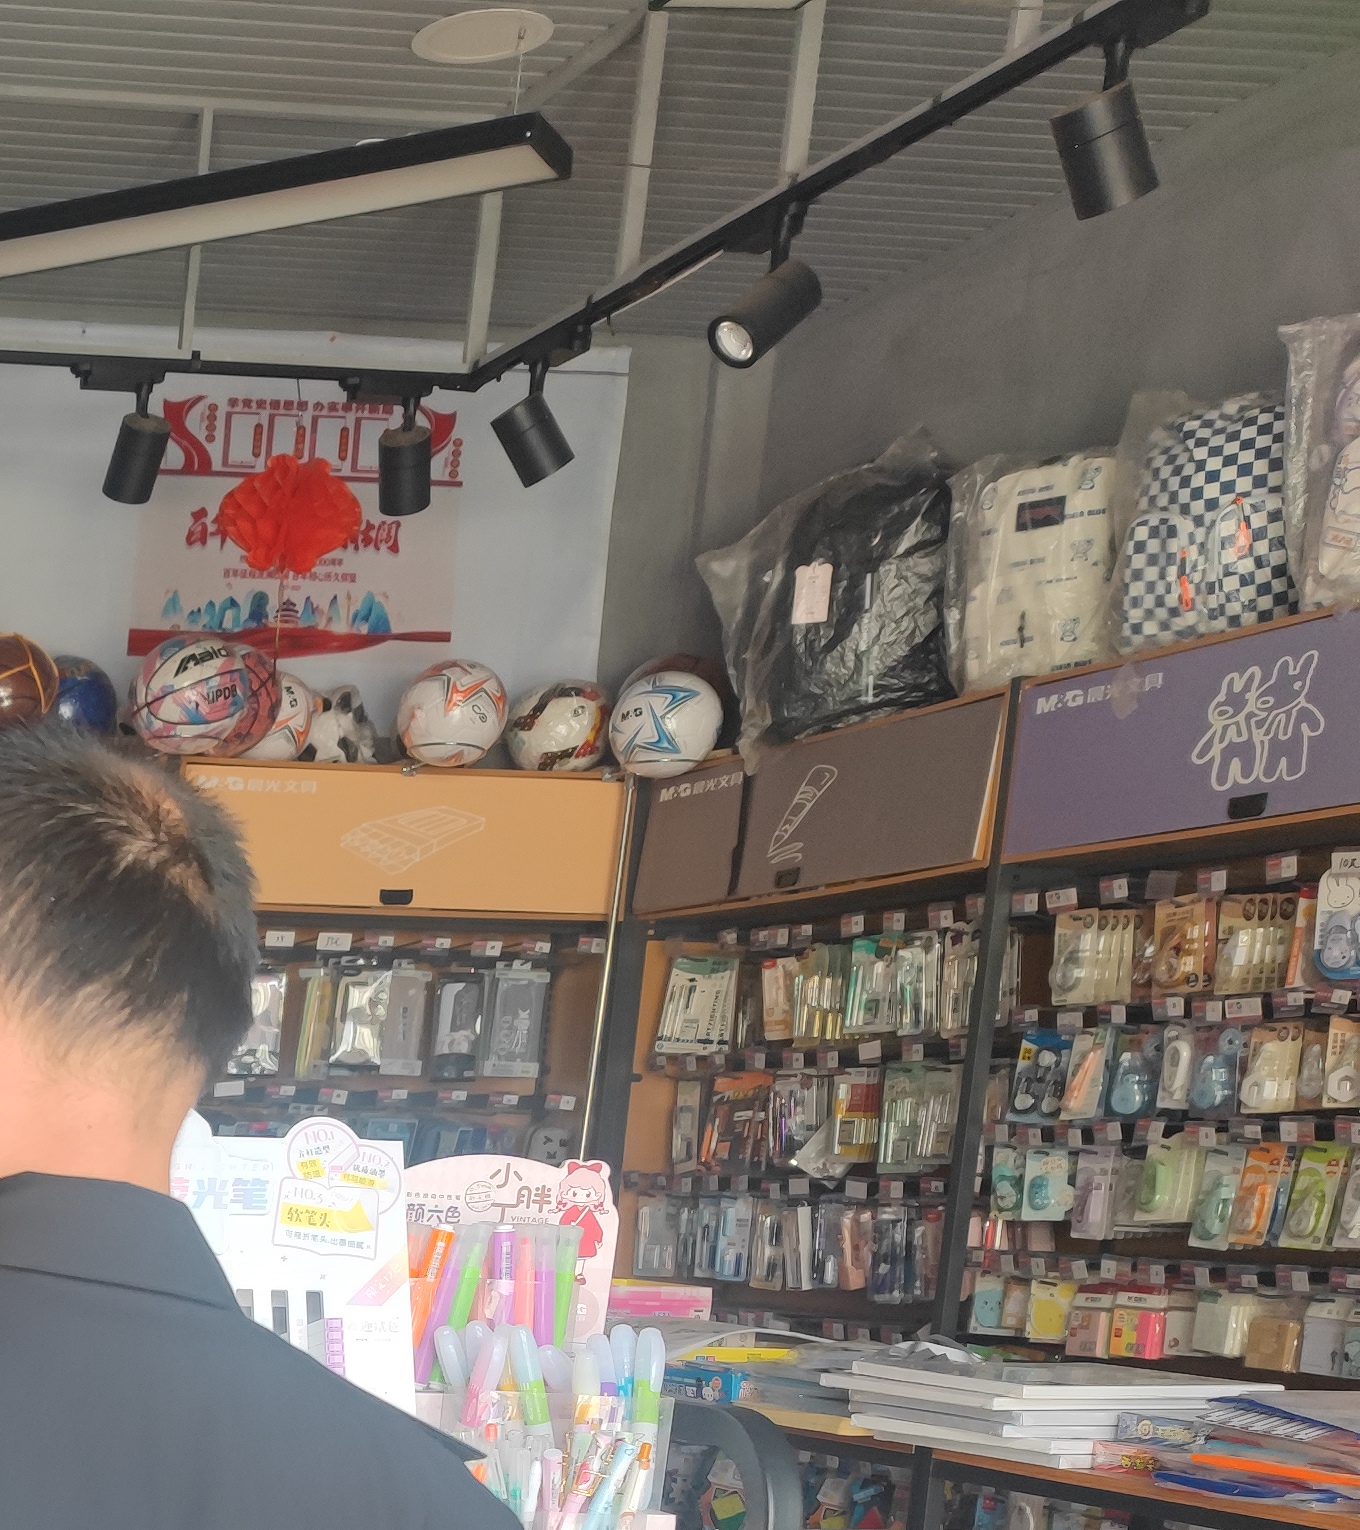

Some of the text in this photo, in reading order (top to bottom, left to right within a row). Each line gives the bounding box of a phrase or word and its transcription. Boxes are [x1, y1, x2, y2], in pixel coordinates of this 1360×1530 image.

[619, 707, 645, 724] M&G
[659, 771, 745, 805] M&G晨光文具
[303, 1128, 336, 1146] NO.1
[292, 1186, 324, 1205] NO.3
[285, 1205, 333, 1230] 软笔头
[510, 1214, 551, 1225] VINTAGE
